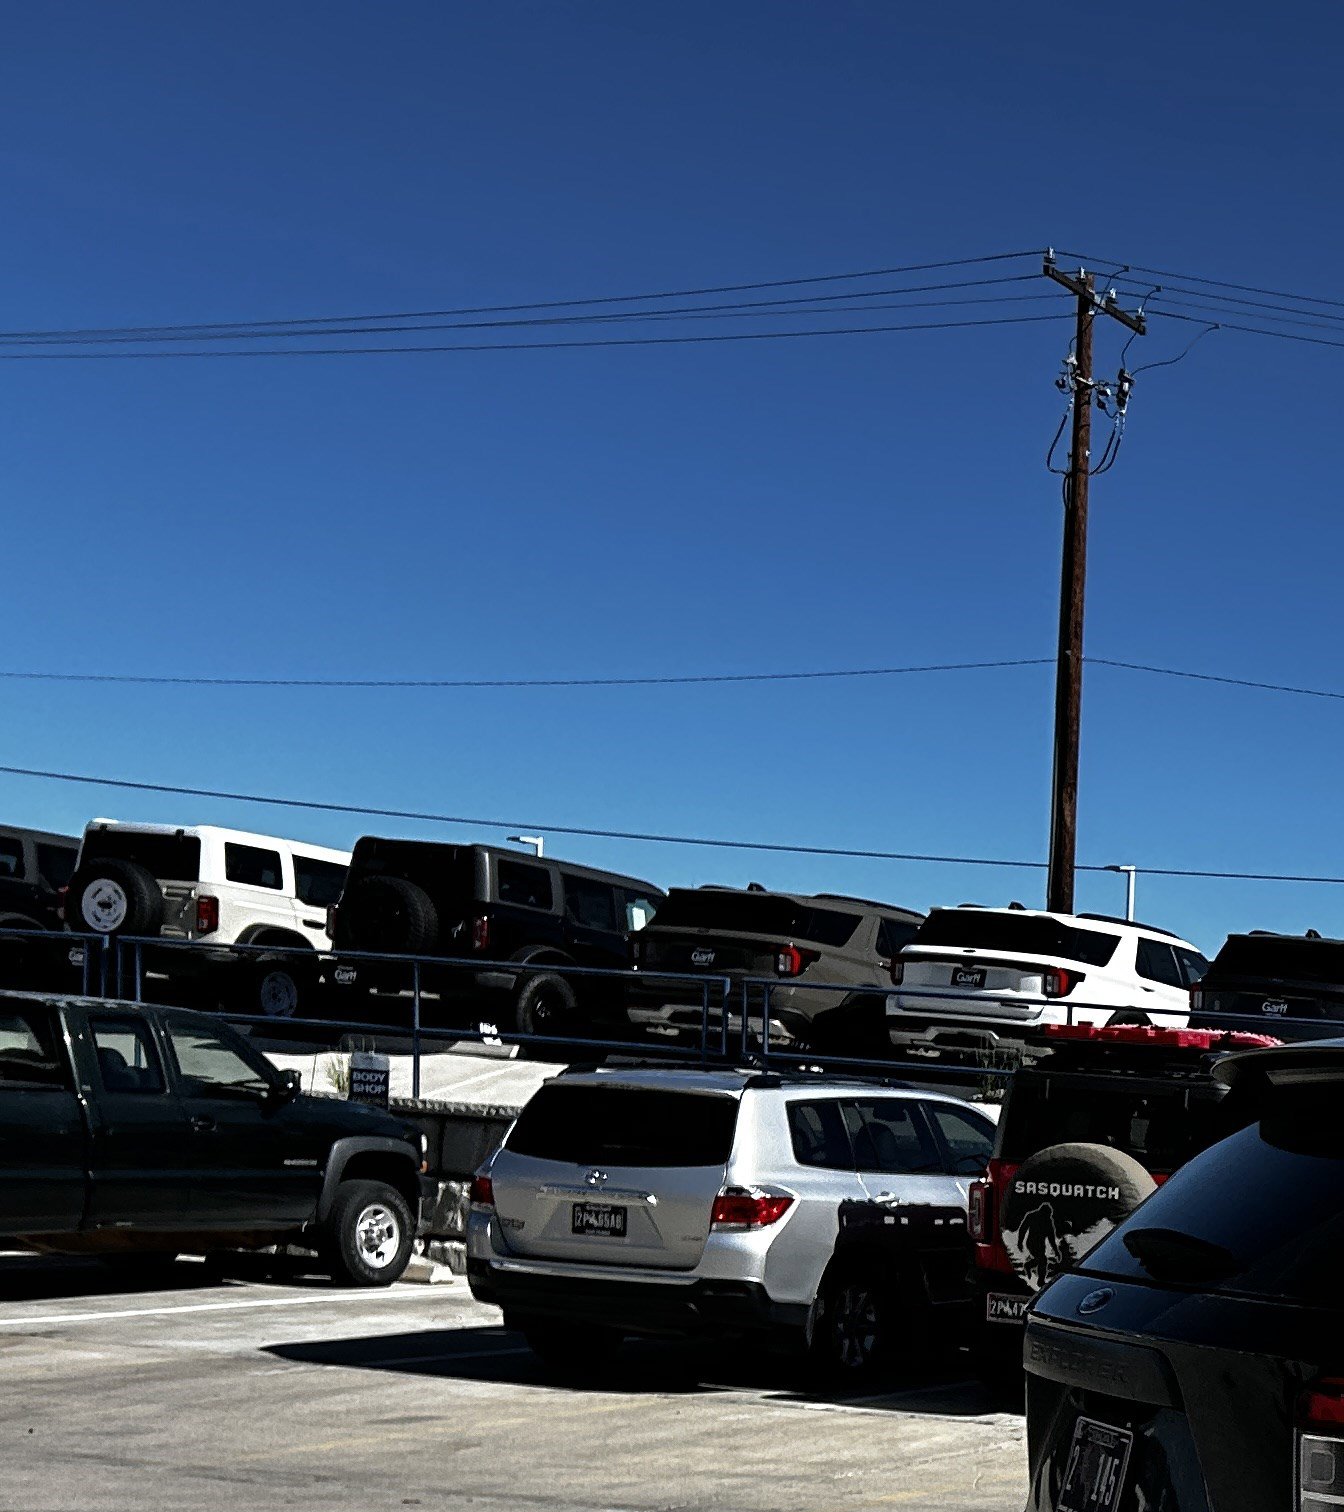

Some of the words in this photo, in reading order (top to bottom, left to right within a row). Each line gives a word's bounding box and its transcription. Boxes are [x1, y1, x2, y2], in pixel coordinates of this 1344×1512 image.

[353, 1071, 386, 1082] BODY
[353, 1083, 386, 1094] SHOP
[1014, 1180, 1120, 1200] SASQUATCH
